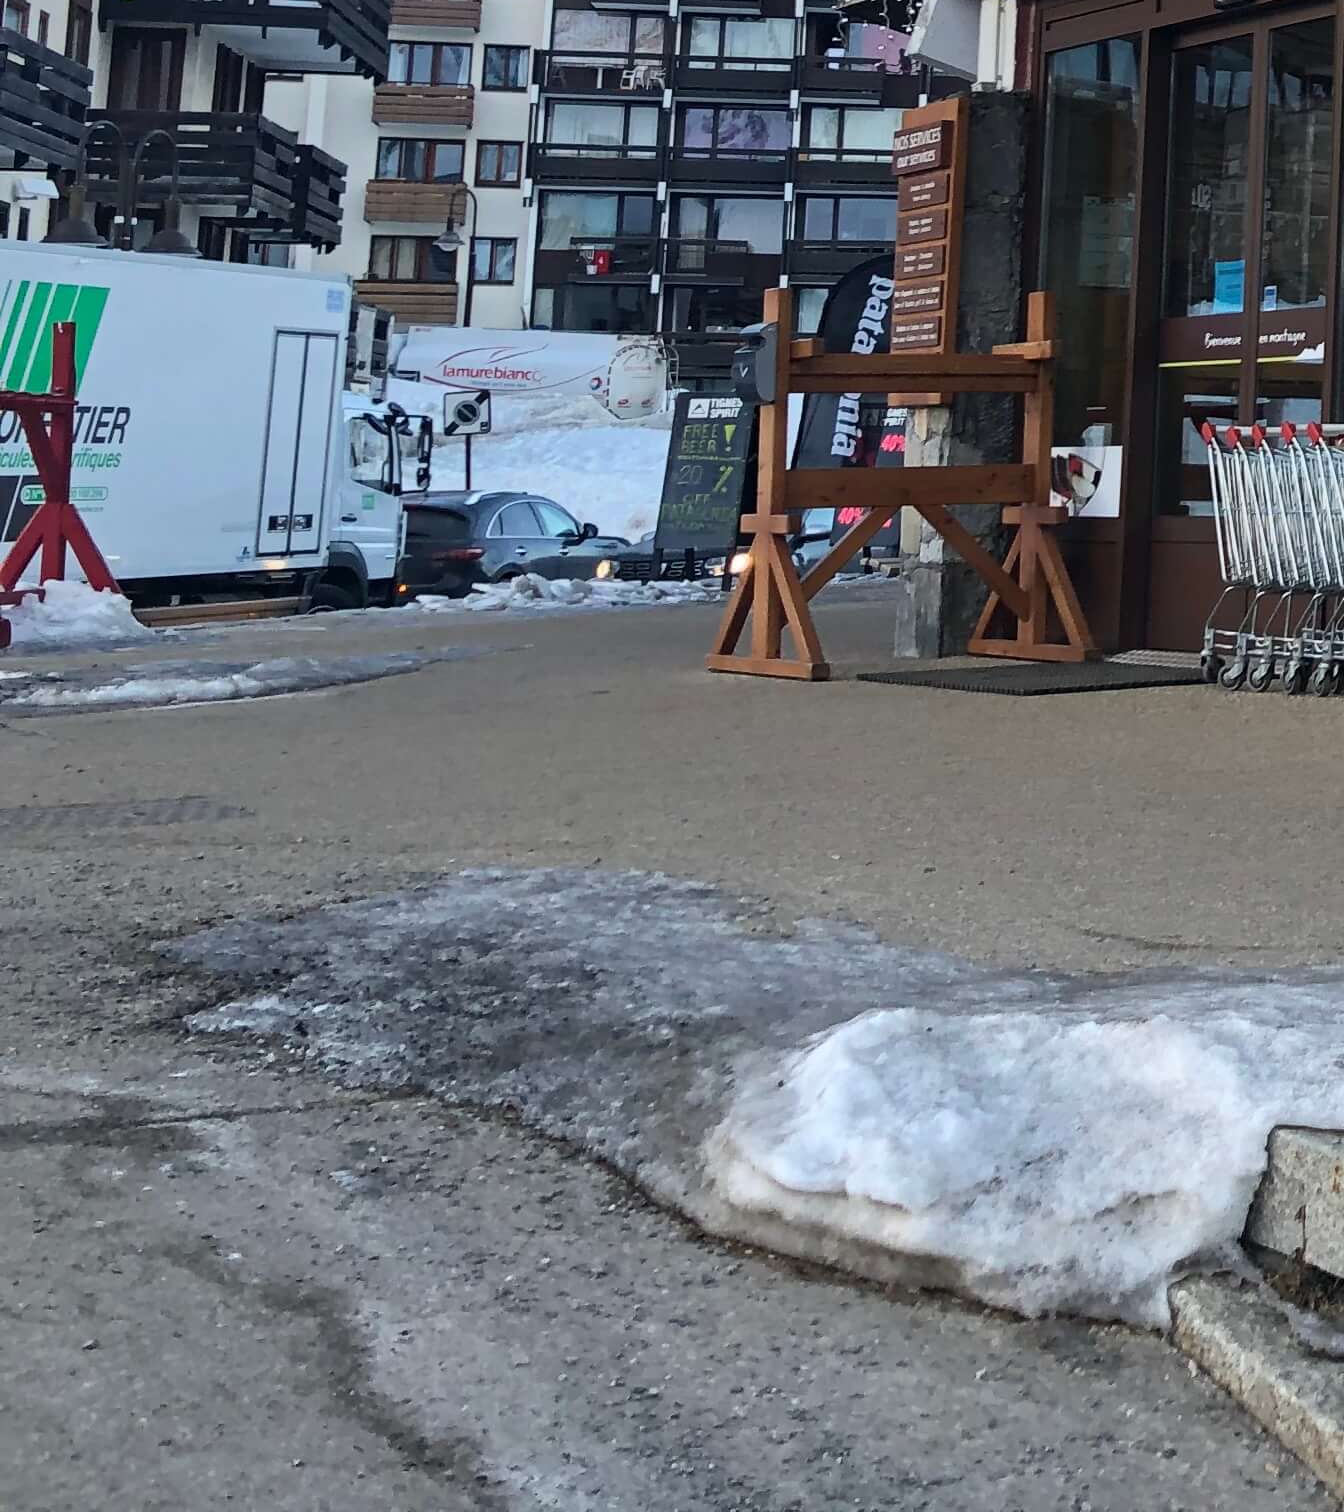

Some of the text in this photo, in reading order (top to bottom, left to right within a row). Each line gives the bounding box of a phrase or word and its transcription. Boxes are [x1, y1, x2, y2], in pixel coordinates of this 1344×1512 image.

[709, 407, 741, 419] SPIRIT
[683, 424, 720, 439] FREE
[681, 439, 717, 454] BEER
